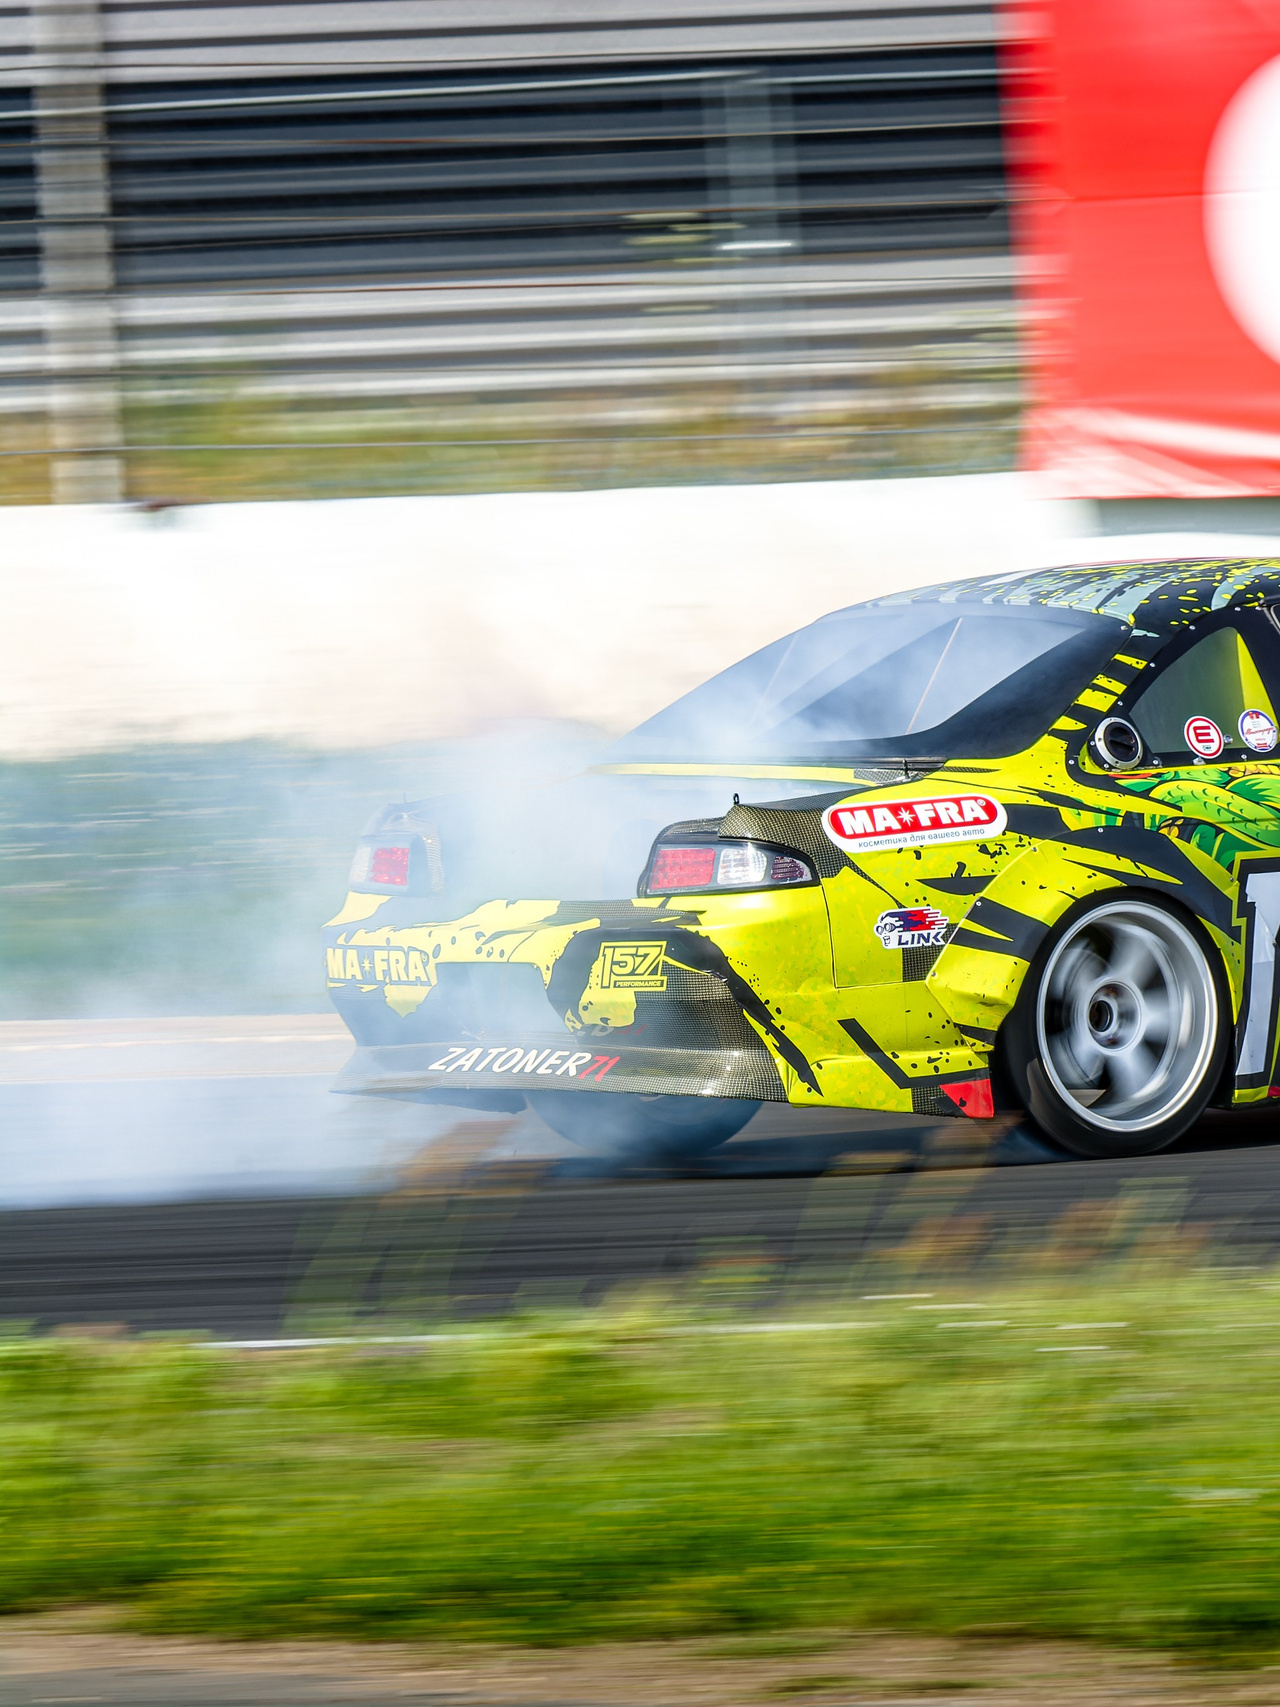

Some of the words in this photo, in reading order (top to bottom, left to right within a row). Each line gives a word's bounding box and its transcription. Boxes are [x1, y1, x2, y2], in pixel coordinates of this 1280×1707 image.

[1192, 725, 1215, 743] E
[858, 836, 908, 848] косметика
[909, 833, 926, 843] для
[927, 830, 961, 841] вашего
[961, 828, 985, 837] авто
[897, 931, 942, 946] LINK
[601, 946, 662, 988] 157
[615, 980, 662, 988] PERFORMANCE
